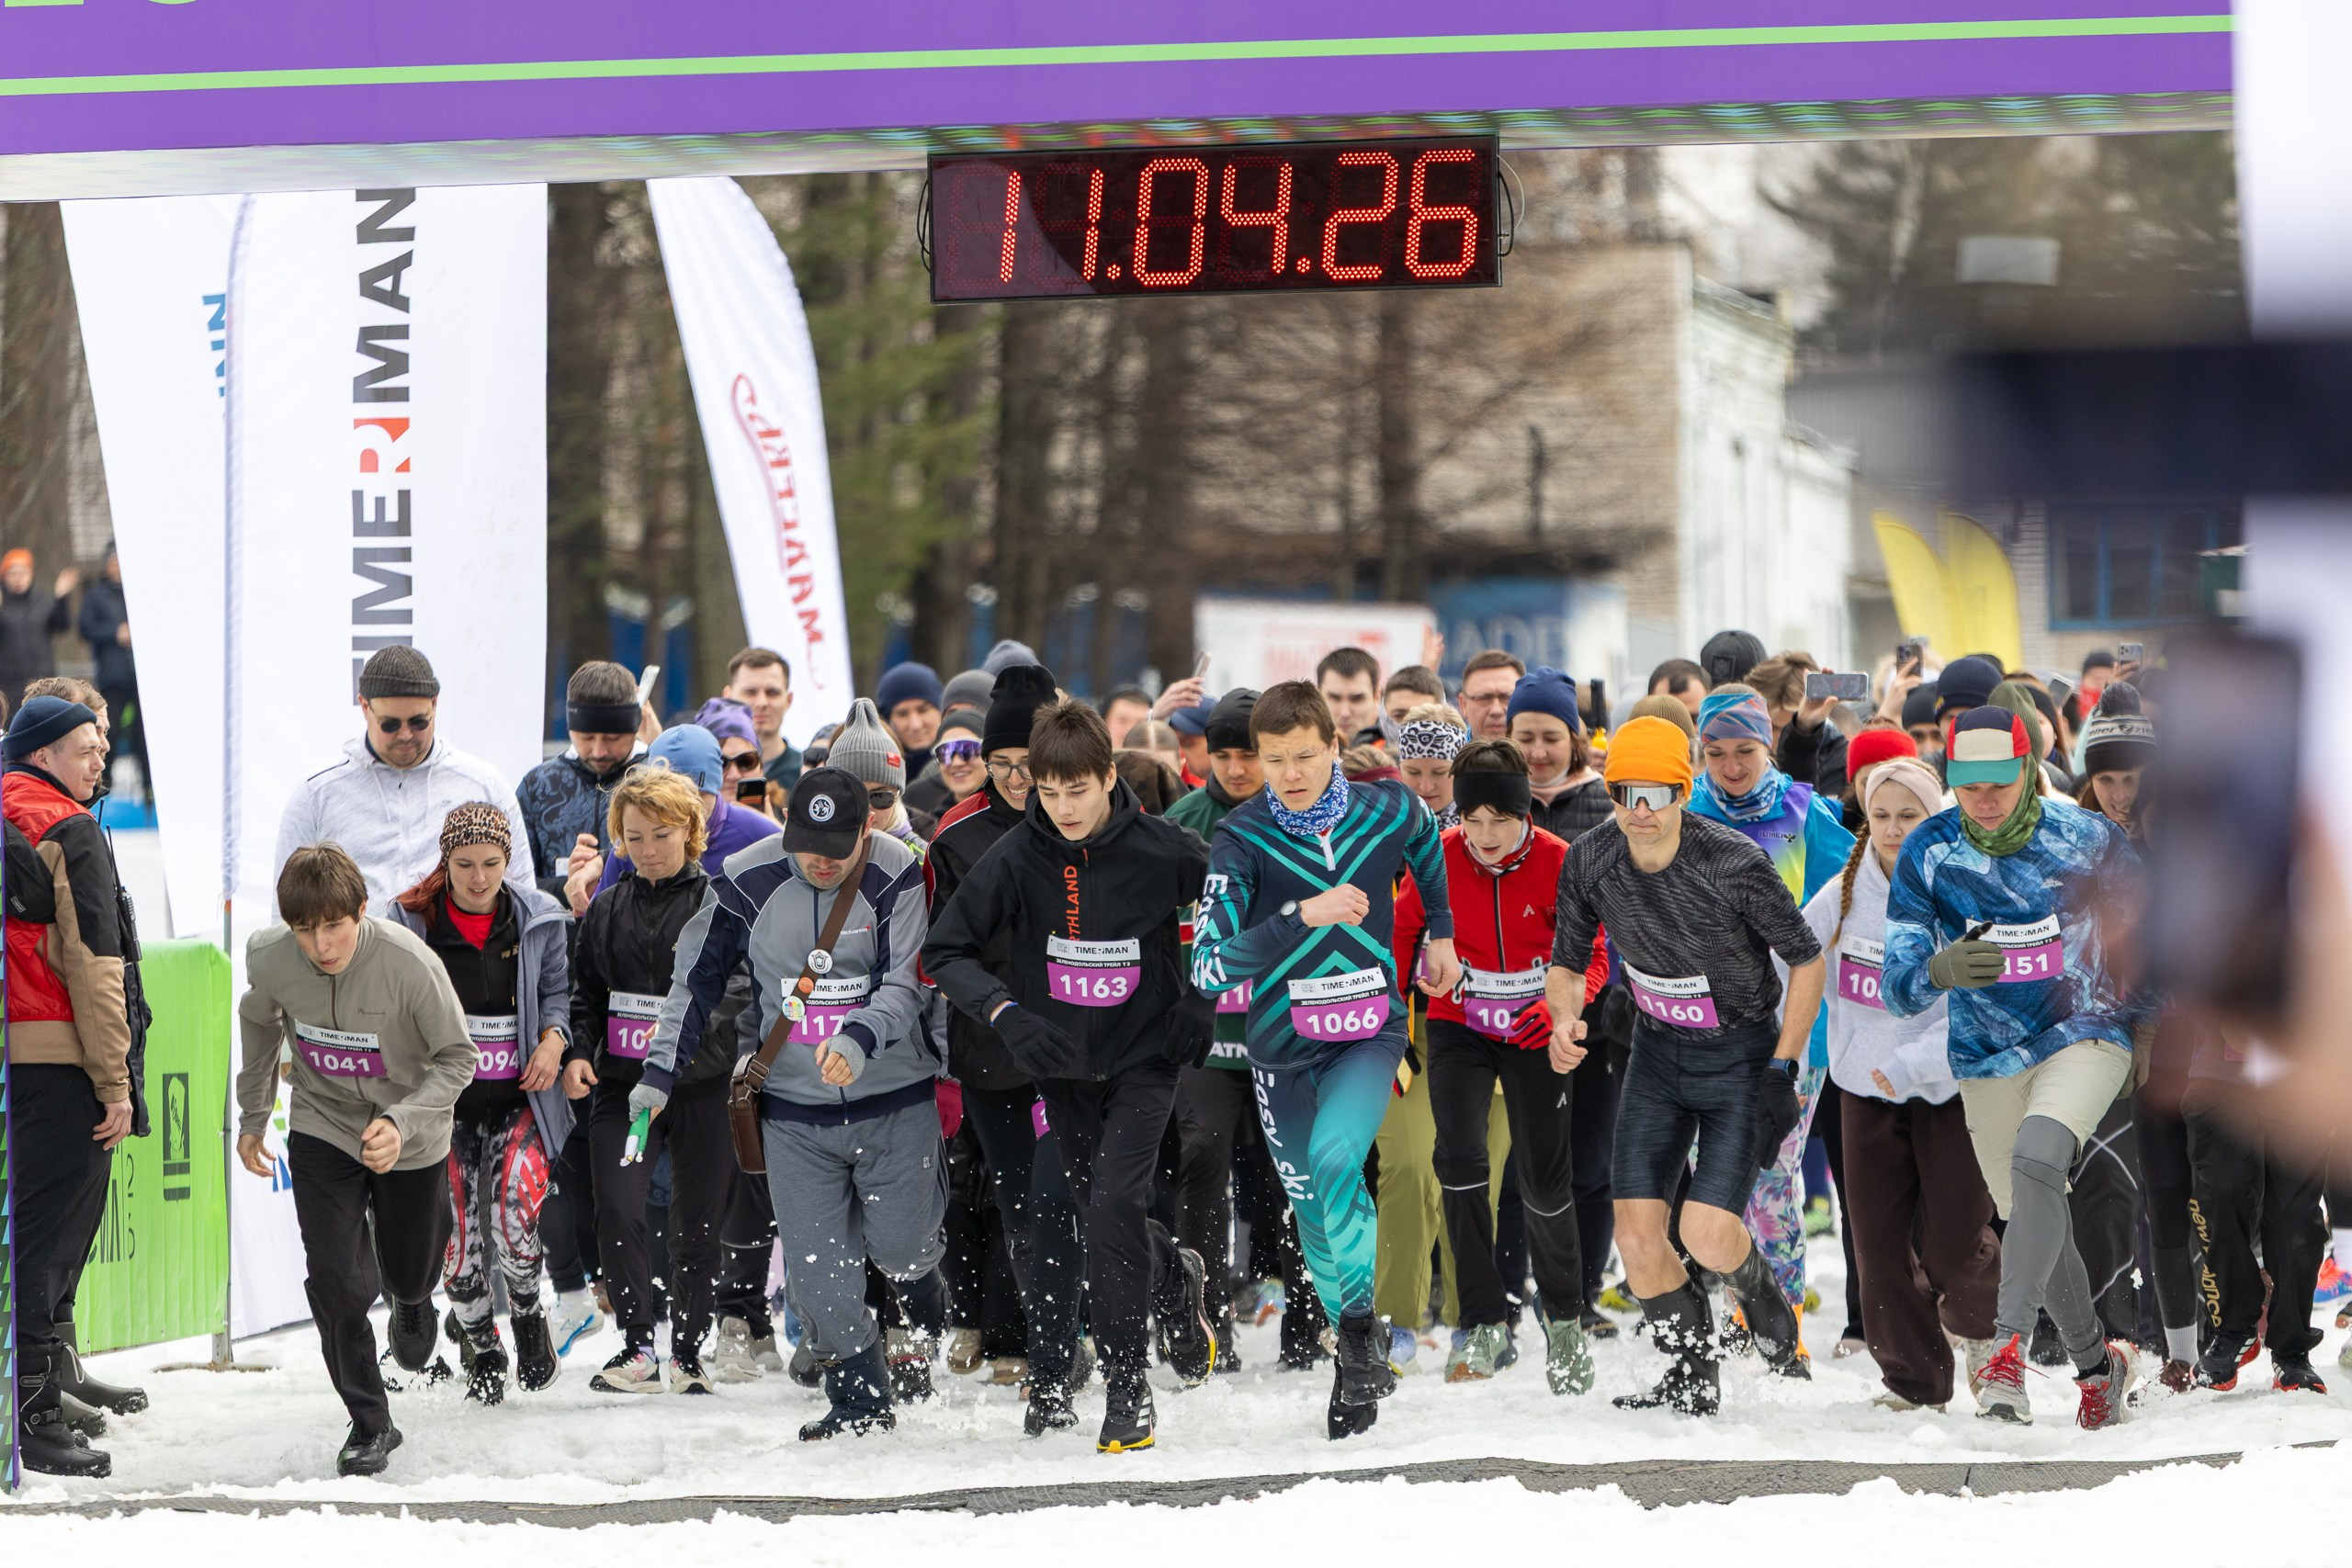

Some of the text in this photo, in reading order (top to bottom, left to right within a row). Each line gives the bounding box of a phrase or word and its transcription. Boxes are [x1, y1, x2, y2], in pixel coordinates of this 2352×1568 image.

[1000, 150, 1479, 286] 11.04.26
[2004, 953, 2049, 976] 151
[1059, 975, 1128, 999] 1163
[1477, 1008, 1510, 1029] 10
[1642, 995, 1704, 1022] 1160
[797, 1014, 845, 1036] 117
[1306, 1007, 1379, 1034] 1066
[617, 1027, 647, 1050] 10
[309, 1051, 370, 1072] 1041
[479, 1051, 520, 1072] 094
[2188, 1199, 2211, 1243] new
